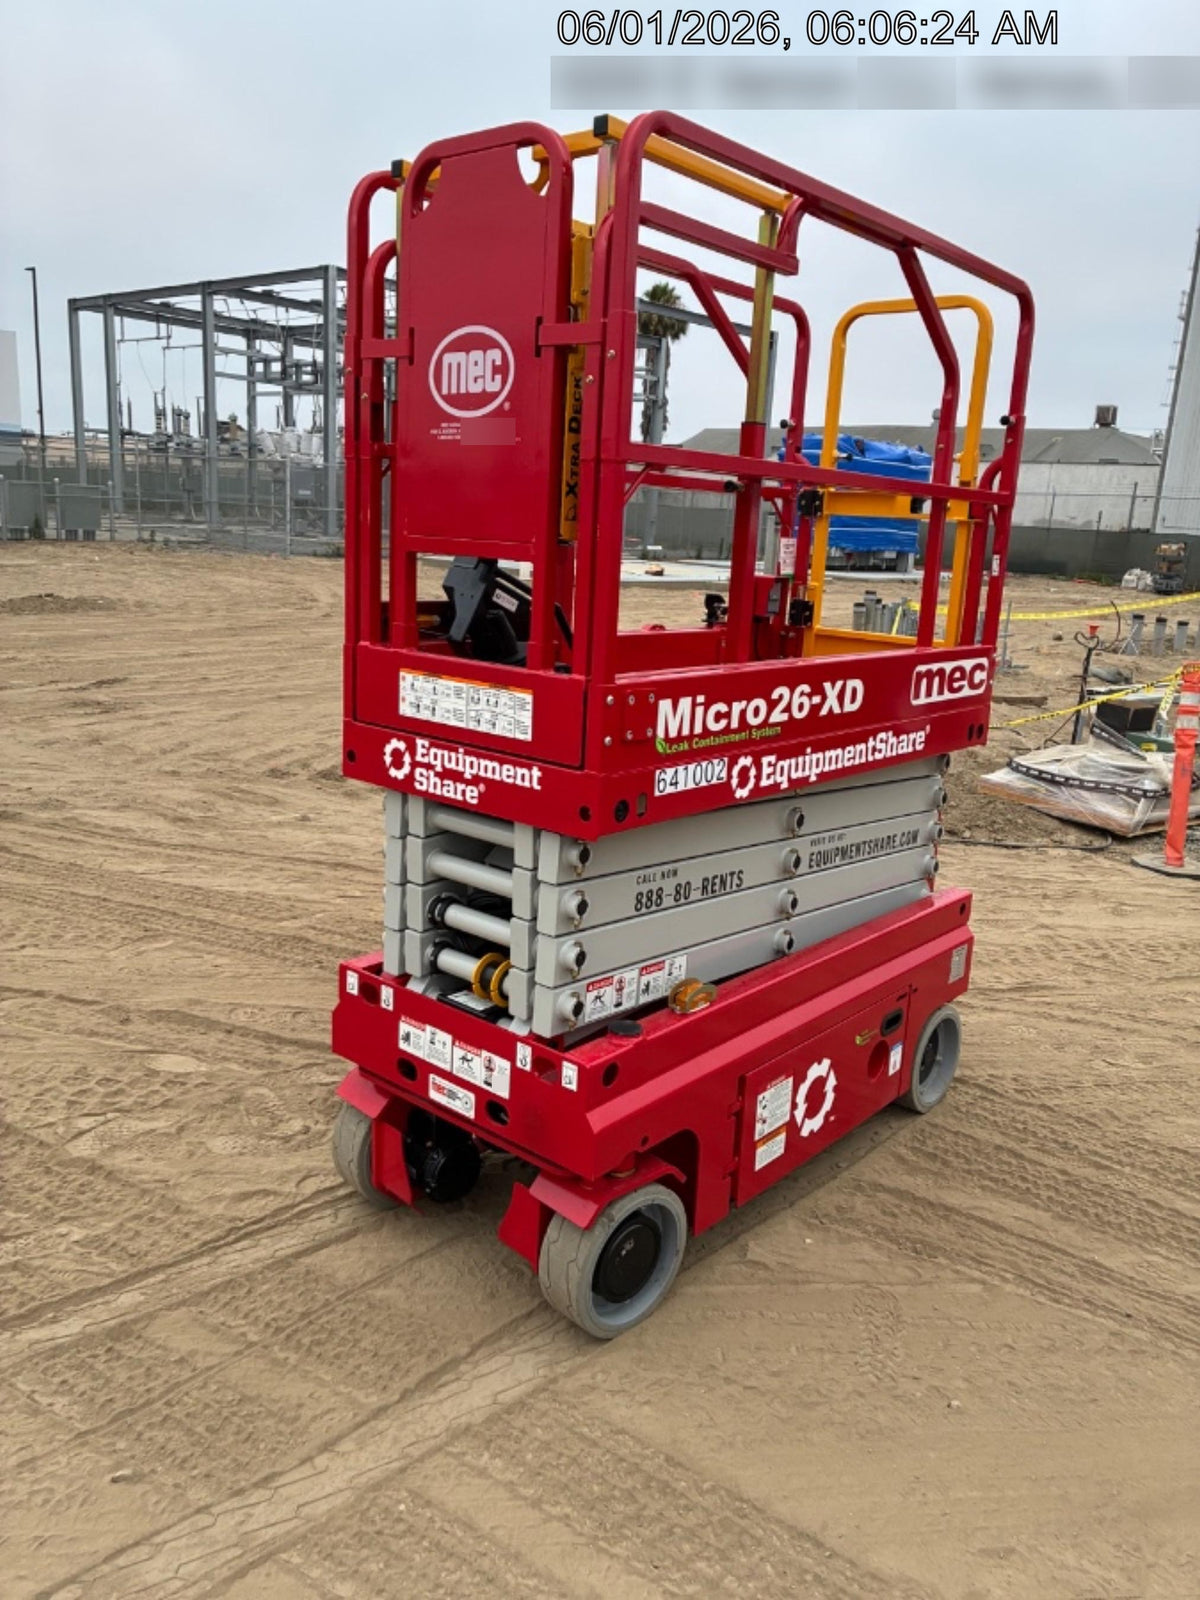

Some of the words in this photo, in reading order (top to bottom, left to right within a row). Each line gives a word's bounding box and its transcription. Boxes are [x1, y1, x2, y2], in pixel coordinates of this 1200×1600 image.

[441, 347, 502, 395] mec
[912, 659, 989, 702] mec
[656, 678, 865, 741] Micro26-XD
[666, 740, 689, 754] Leak
[692, 729, 749, 748] Containment
[750, 725, 782, 740] System
[414, 738, 542, 790] Equipment
[656, 758, 727, 794] 641002
[808, 828, 920, 870] EQUIPMENTSHARE.COM
[634, 869, 744, 912] 888-80-RENTS
[636, 872, 657, 886] CALL
[661, 868, 678, 880] NOW
